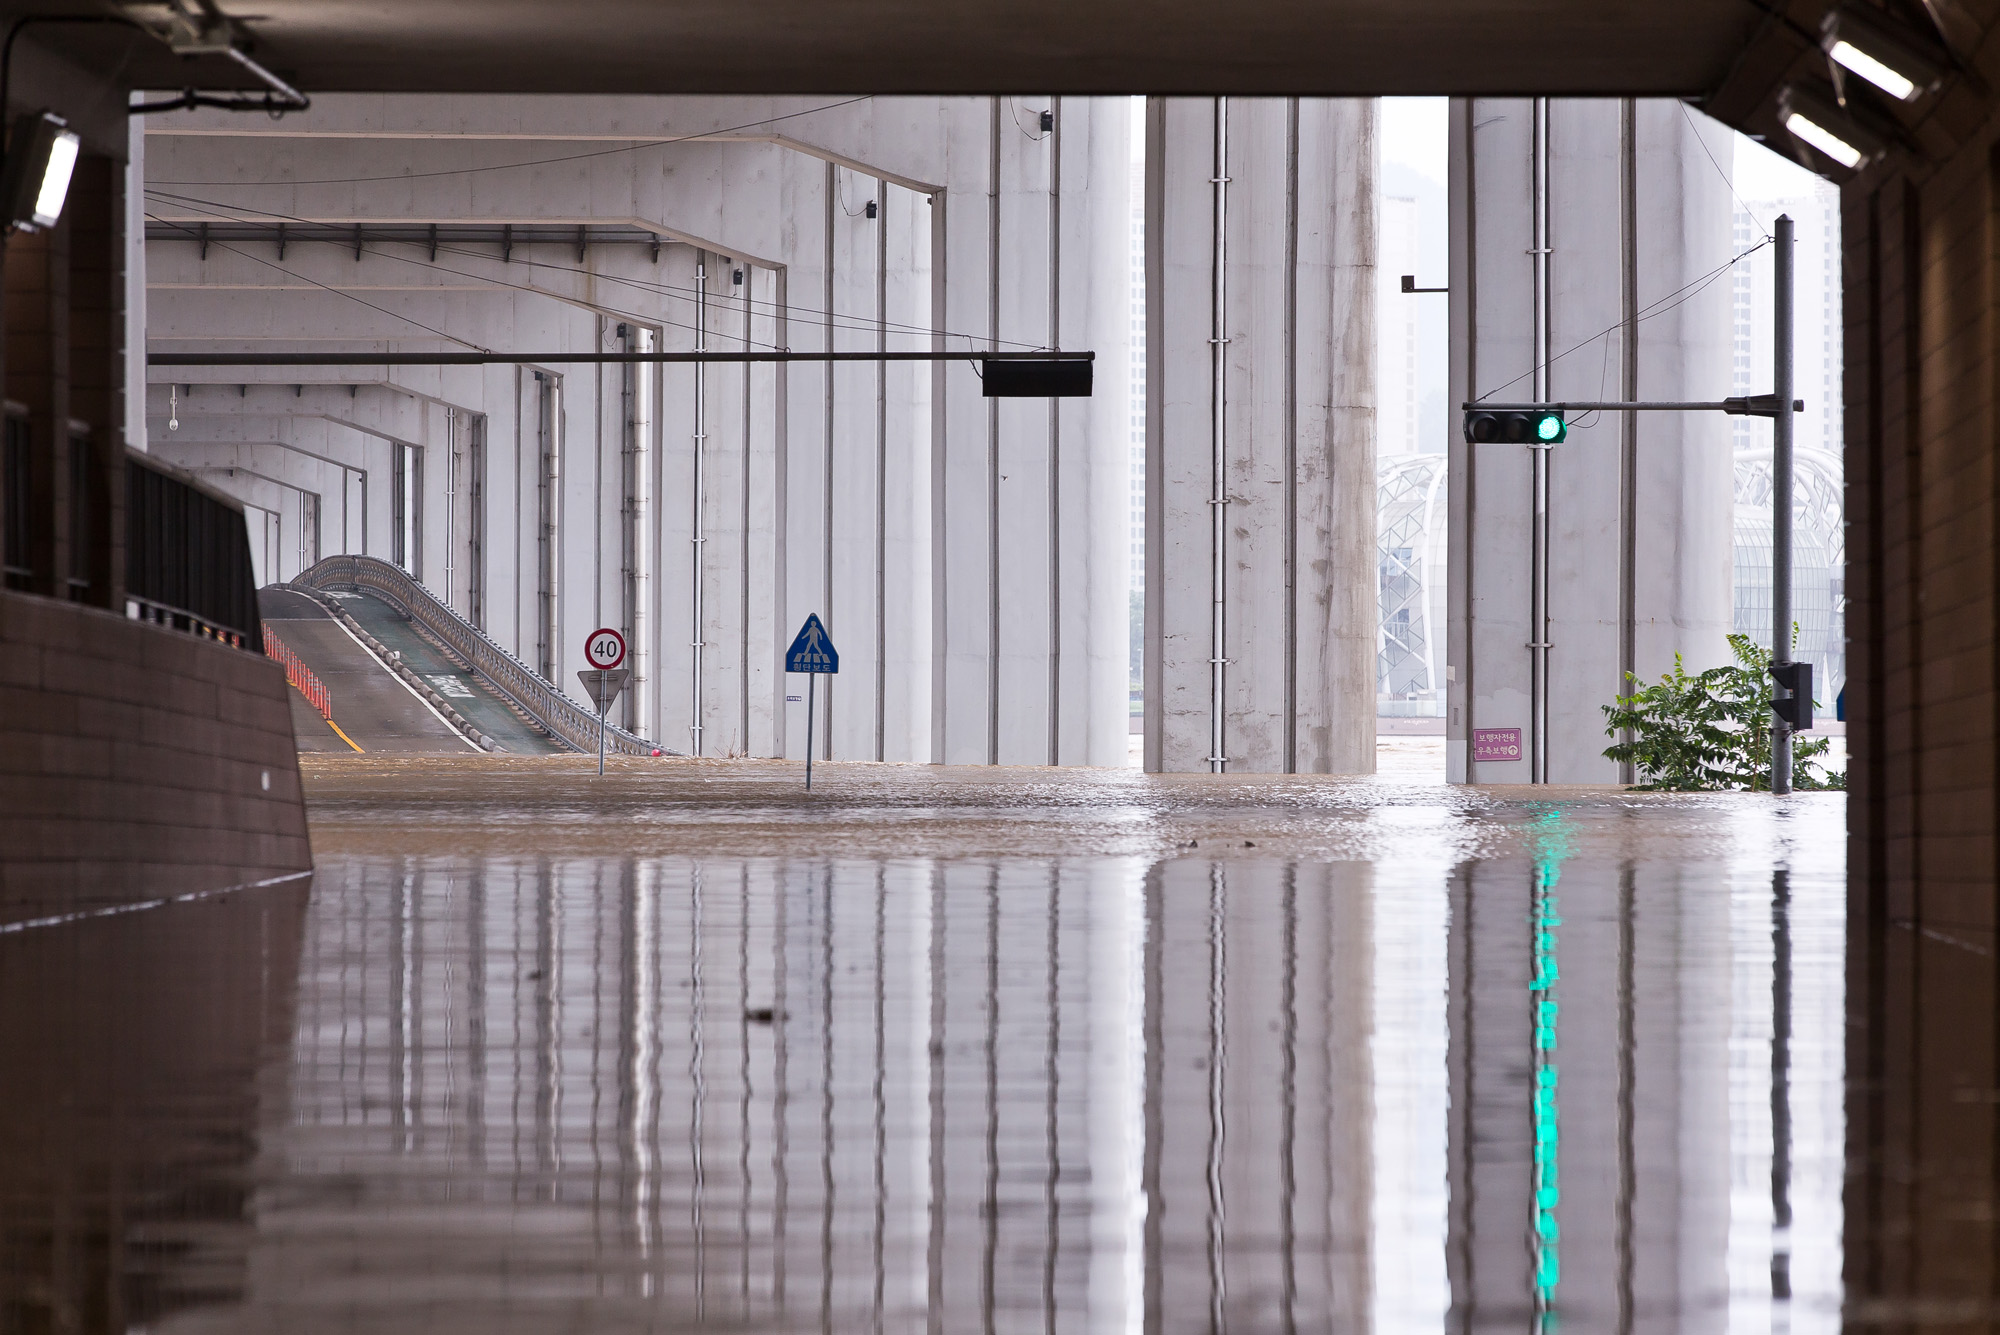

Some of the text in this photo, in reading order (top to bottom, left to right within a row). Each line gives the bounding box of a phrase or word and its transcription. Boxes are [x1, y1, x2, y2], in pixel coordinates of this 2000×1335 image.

[594, 640, 617, 658] 40
[793, 663, 831, 671] 횡단보도
[1478, 733, 1516, 742] 보행자전용
[1477, 746, 1508, 755] 우측보행
